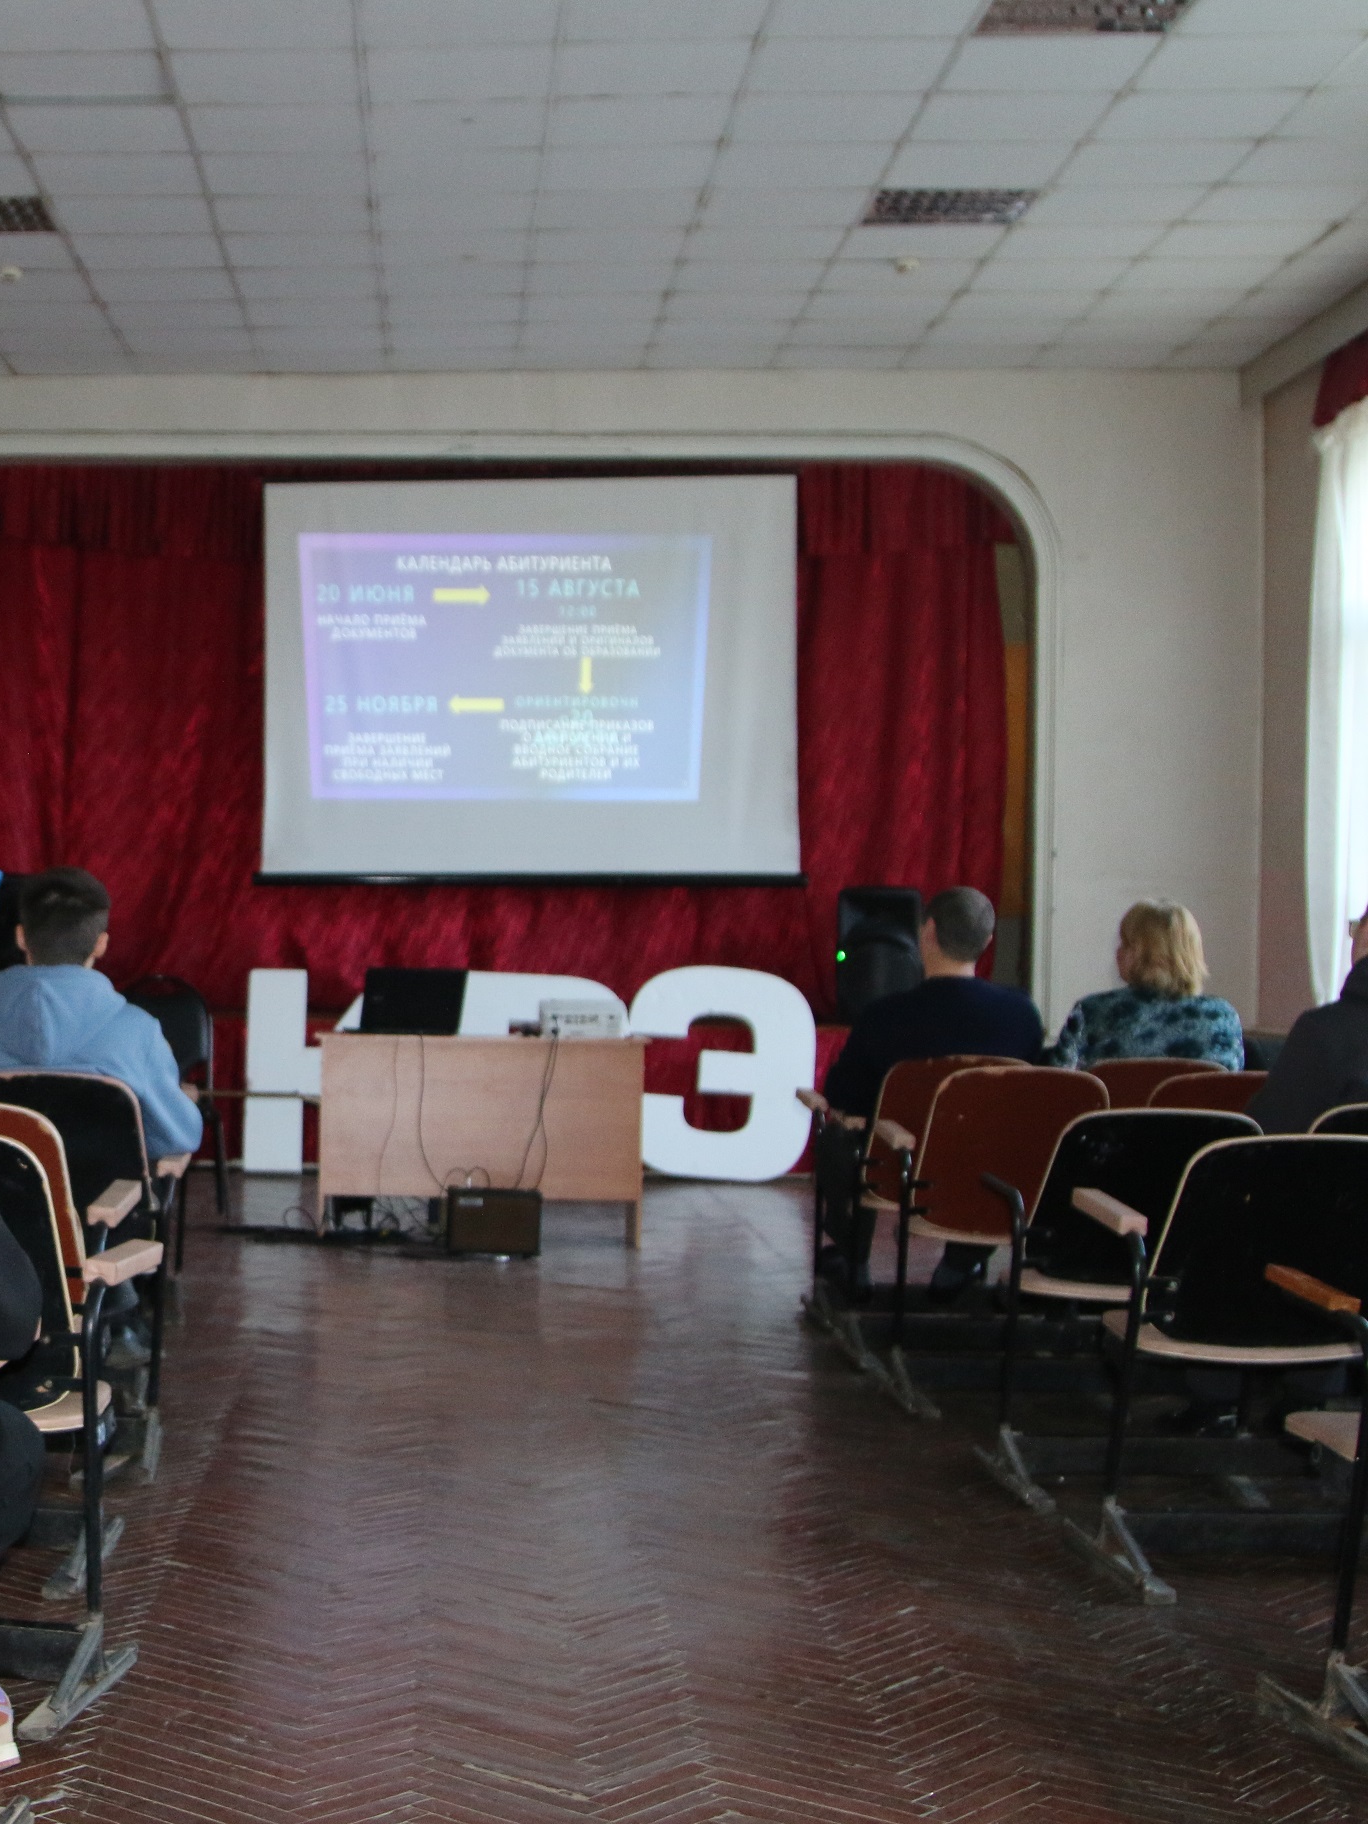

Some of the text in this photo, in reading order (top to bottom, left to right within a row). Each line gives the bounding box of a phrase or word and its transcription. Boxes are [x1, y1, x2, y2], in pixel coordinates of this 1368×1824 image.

[395, 555, 612, 574] КАЛЕНДАРЬ АБИТУРИЕНТА
[316, 583, 415, 603] 20 ИЮНЯ
[516, 578, 641, 598] 15 АВГУСТА
[324, 695, 438, 714] 25 НОЯБРЯ
